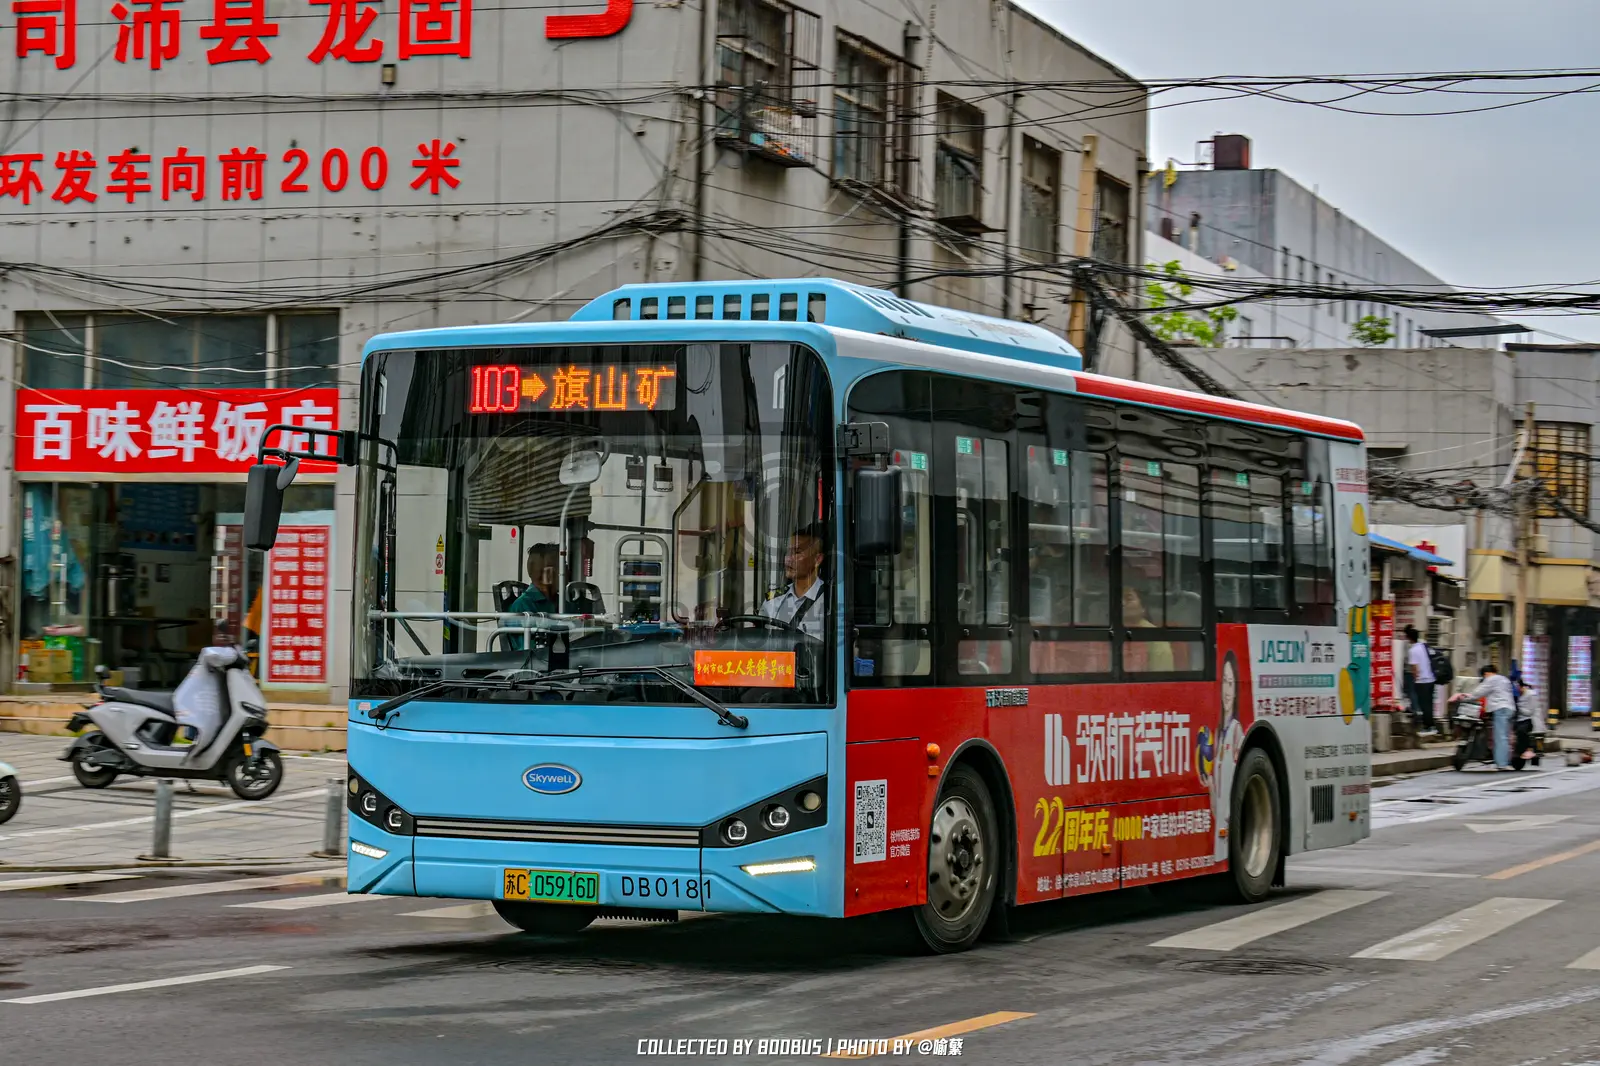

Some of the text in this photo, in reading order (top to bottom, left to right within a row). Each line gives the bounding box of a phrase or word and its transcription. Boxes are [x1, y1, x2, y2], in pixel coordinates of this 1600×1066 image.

[471, 364, 675, 413] 103 旗山矿
[24, 400, 334, 462] 百味鲜饭店
[1257, 640, 1305, 663] JASON
[1076, 711, 1191, 784] 领航装饰
[528, 773, 574, 785] Skywell
